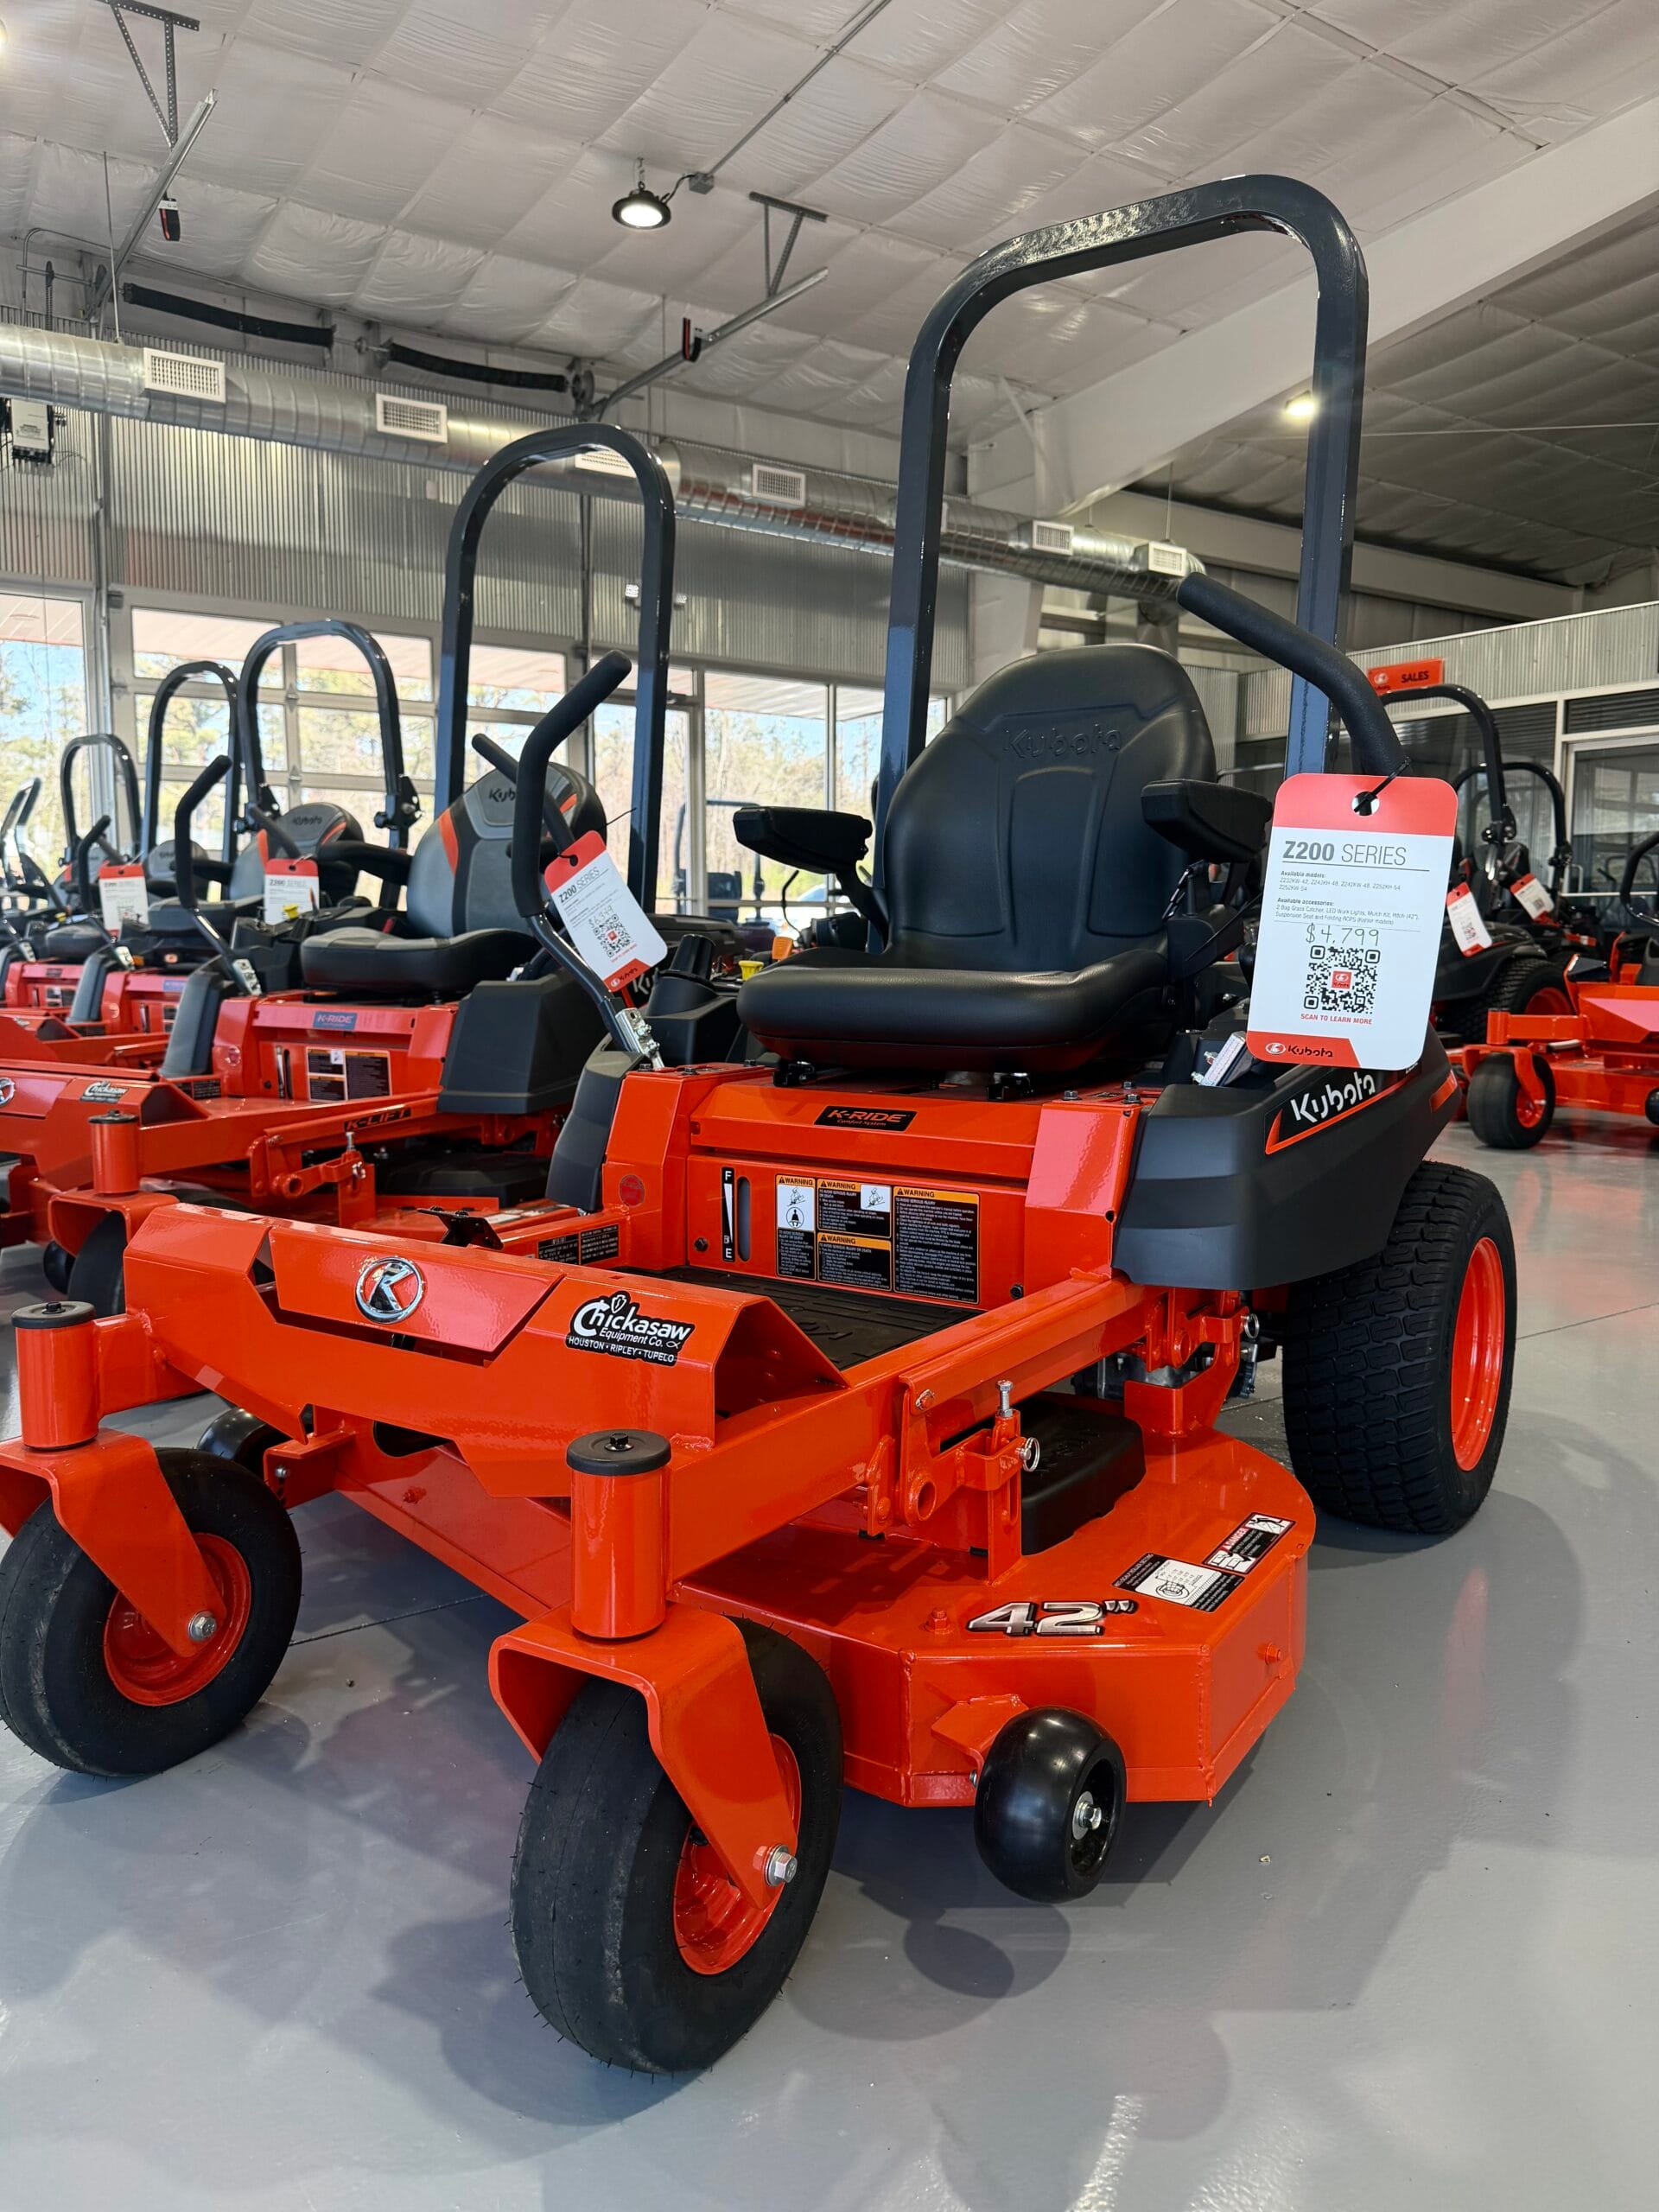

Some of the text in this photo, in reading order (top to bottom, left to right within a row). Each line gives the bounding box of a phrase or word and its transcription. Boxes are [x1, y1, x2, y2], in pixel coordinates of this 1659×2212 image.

[1401, 671, 1429, 683] SALES
[1003, 724, 1121, 759] Kubota
[489, 787, 517, 803] Kub
[1282, 841, 1407, 866] Z200 SERIES
[1277, 897, 1334, 907] Available accessories:
[317, 1014, 354, 1024] K-RIDE
[1300, 1013, 1318, 1021] SCAN
[1330, 1015, 1351, 1024] LEARN
[1353, 1017, 1373, 1026] MORE
[1287, 1045, 1333, 1058] Kubota
[1290, 1071, 1376, 1123] Kubota
[346, 1109, 410, 1131] K-LIFT
[827, 1109, 907, 1123] K-RIDE
[724, 1170, 733, 1181] F
[785, 1176, 813, 1186] WARNING
[826, 1180, 856, 1191] WARNING
[903, 1188, 935, 1198] WARNING
[826, 1235, 856, 1245] WARNING
[725, 1248, 733, 1259] E
[573, 1299, 692, 1341] Chickasaw
[599, 1327, 664, 1348] Equipment Co.
[569, 1336, 675, 1363] HOUSTON RIPLEY TUPELO
[1225, 1526, 1249, 1548] DANGER
[967, 1599, 1138, 1637] 42"
